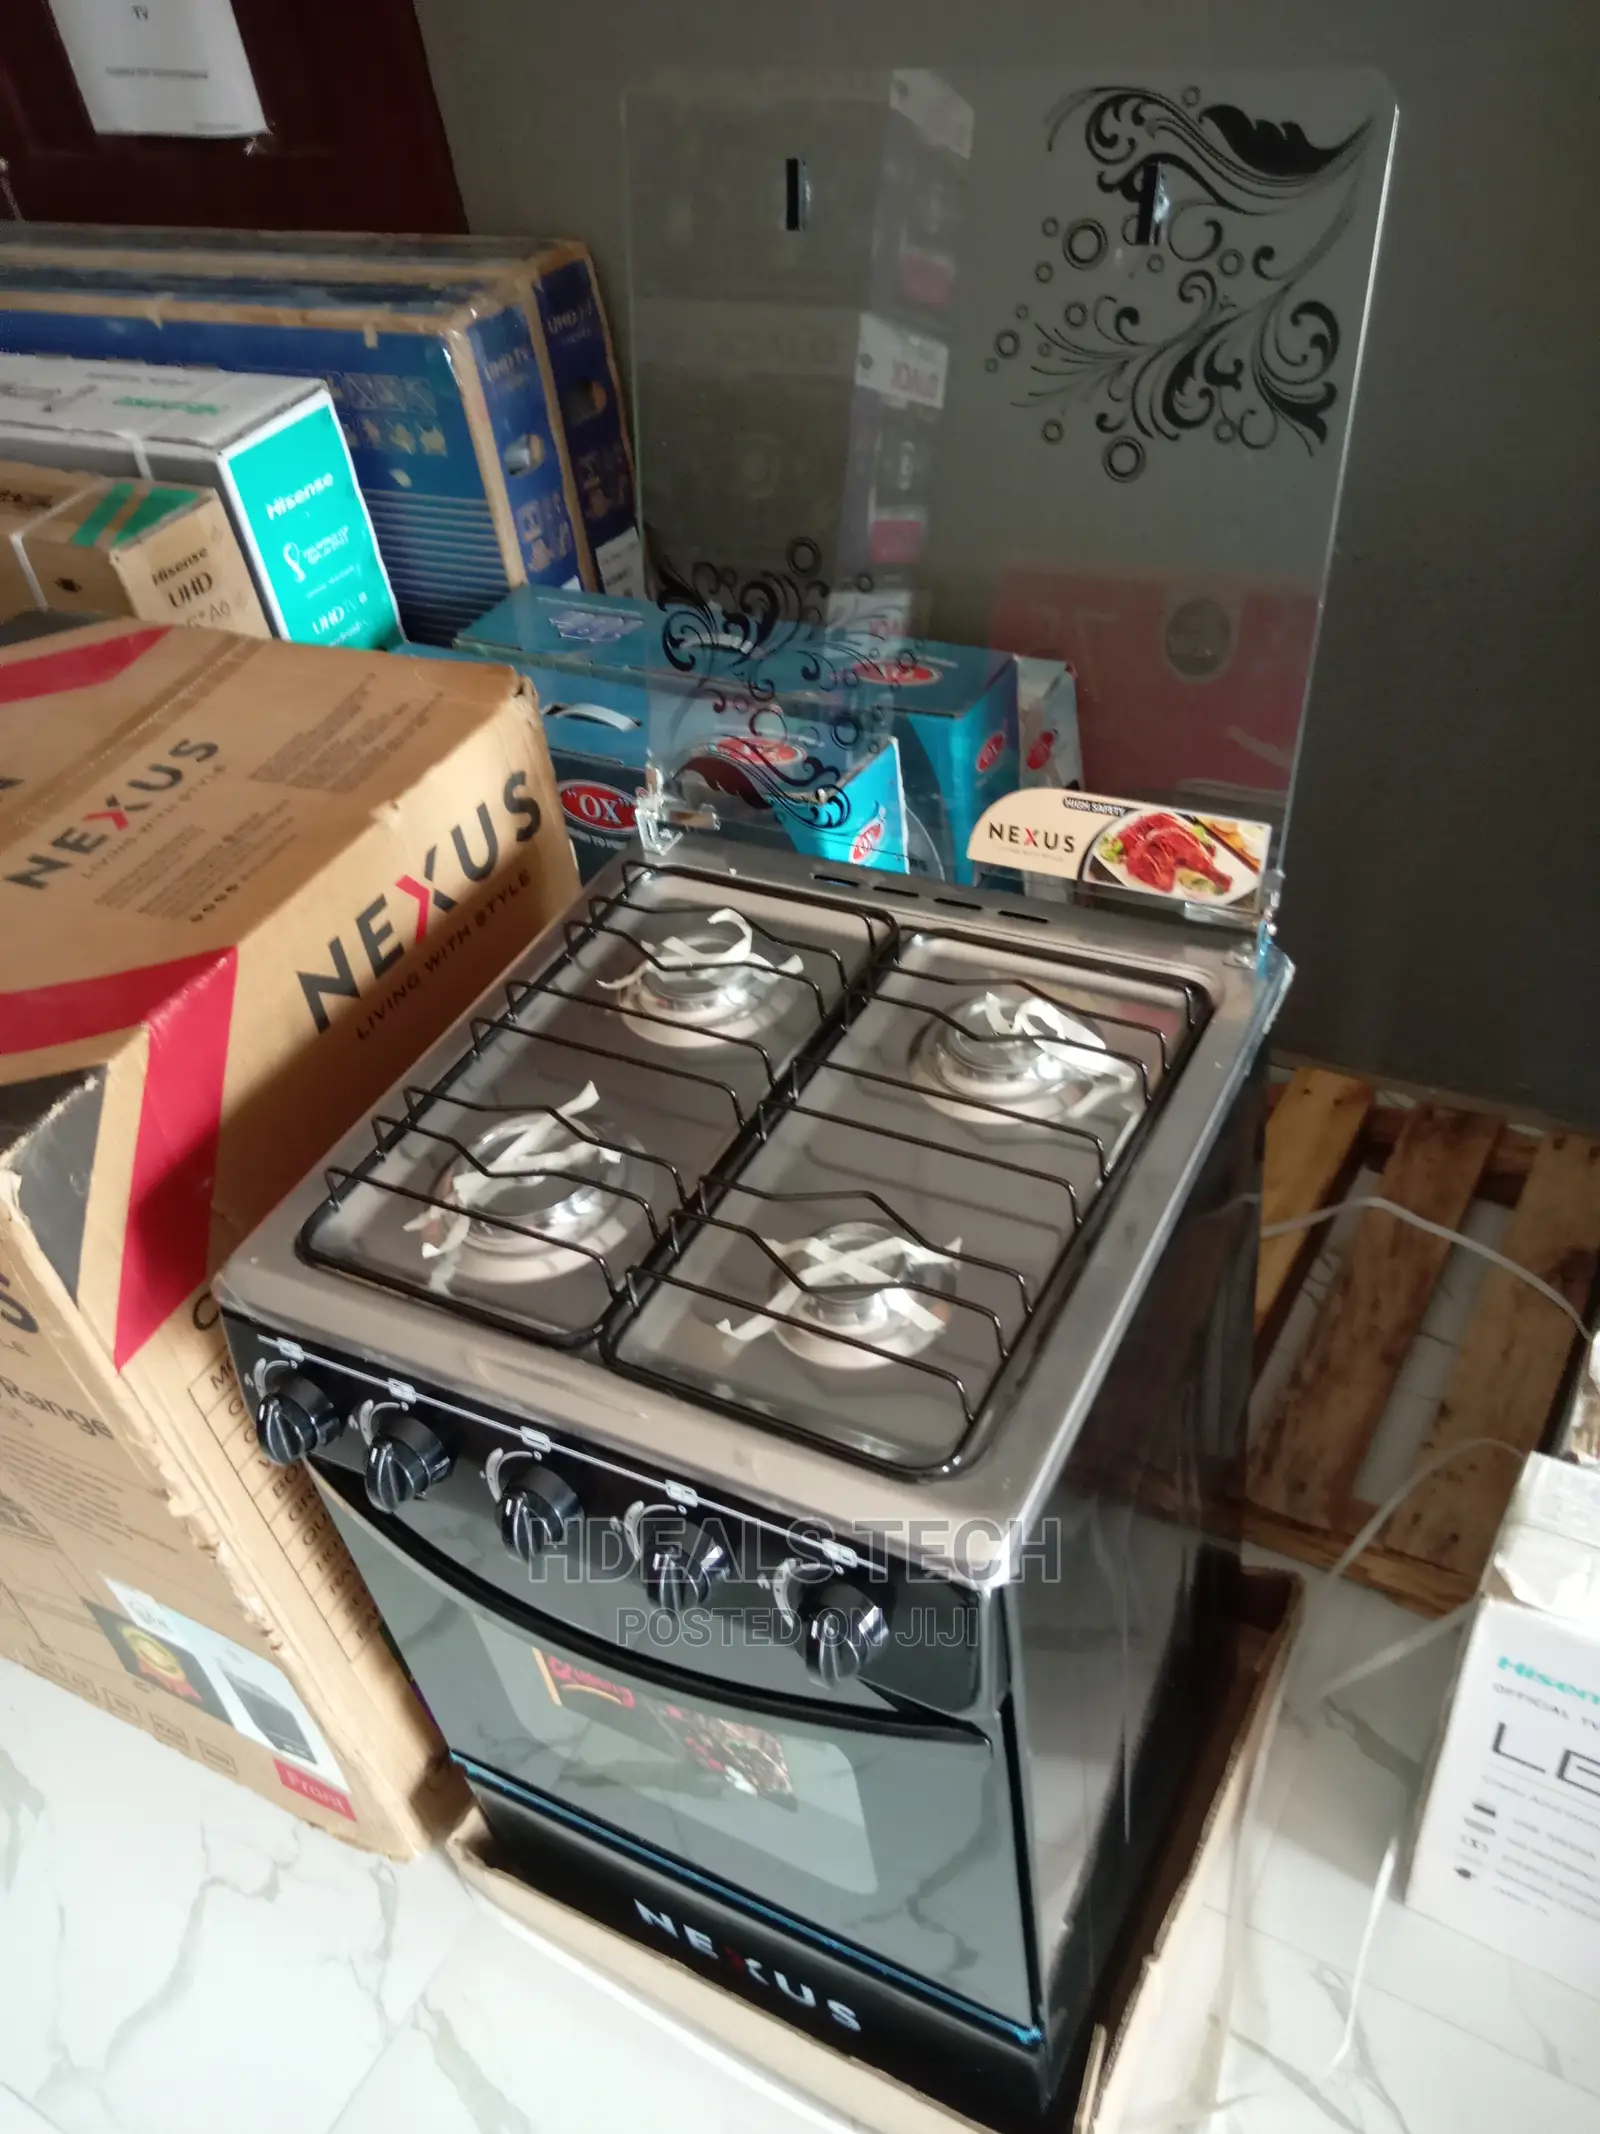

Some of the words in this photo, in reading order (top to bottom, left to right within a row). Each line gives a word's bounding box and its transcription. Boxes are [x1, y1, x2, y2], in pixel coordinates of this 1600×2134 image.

[265, 472, 335, 521] Hisense
[151, 547, 208, 586] Hisense
[168, 571, 214, 609] UHD
[4, 738, 220, 890] NEXUS
[988, 822, 1076, 853] NEXUS
[296, 770, 542, 1035] NEXUS
[355, 972, 421, 1041] LIVING
[424, 924, 472, 974] WITH
[474, 869, 532, 927] STYLE
[633, 1897, 862, 2032] NEXUS
